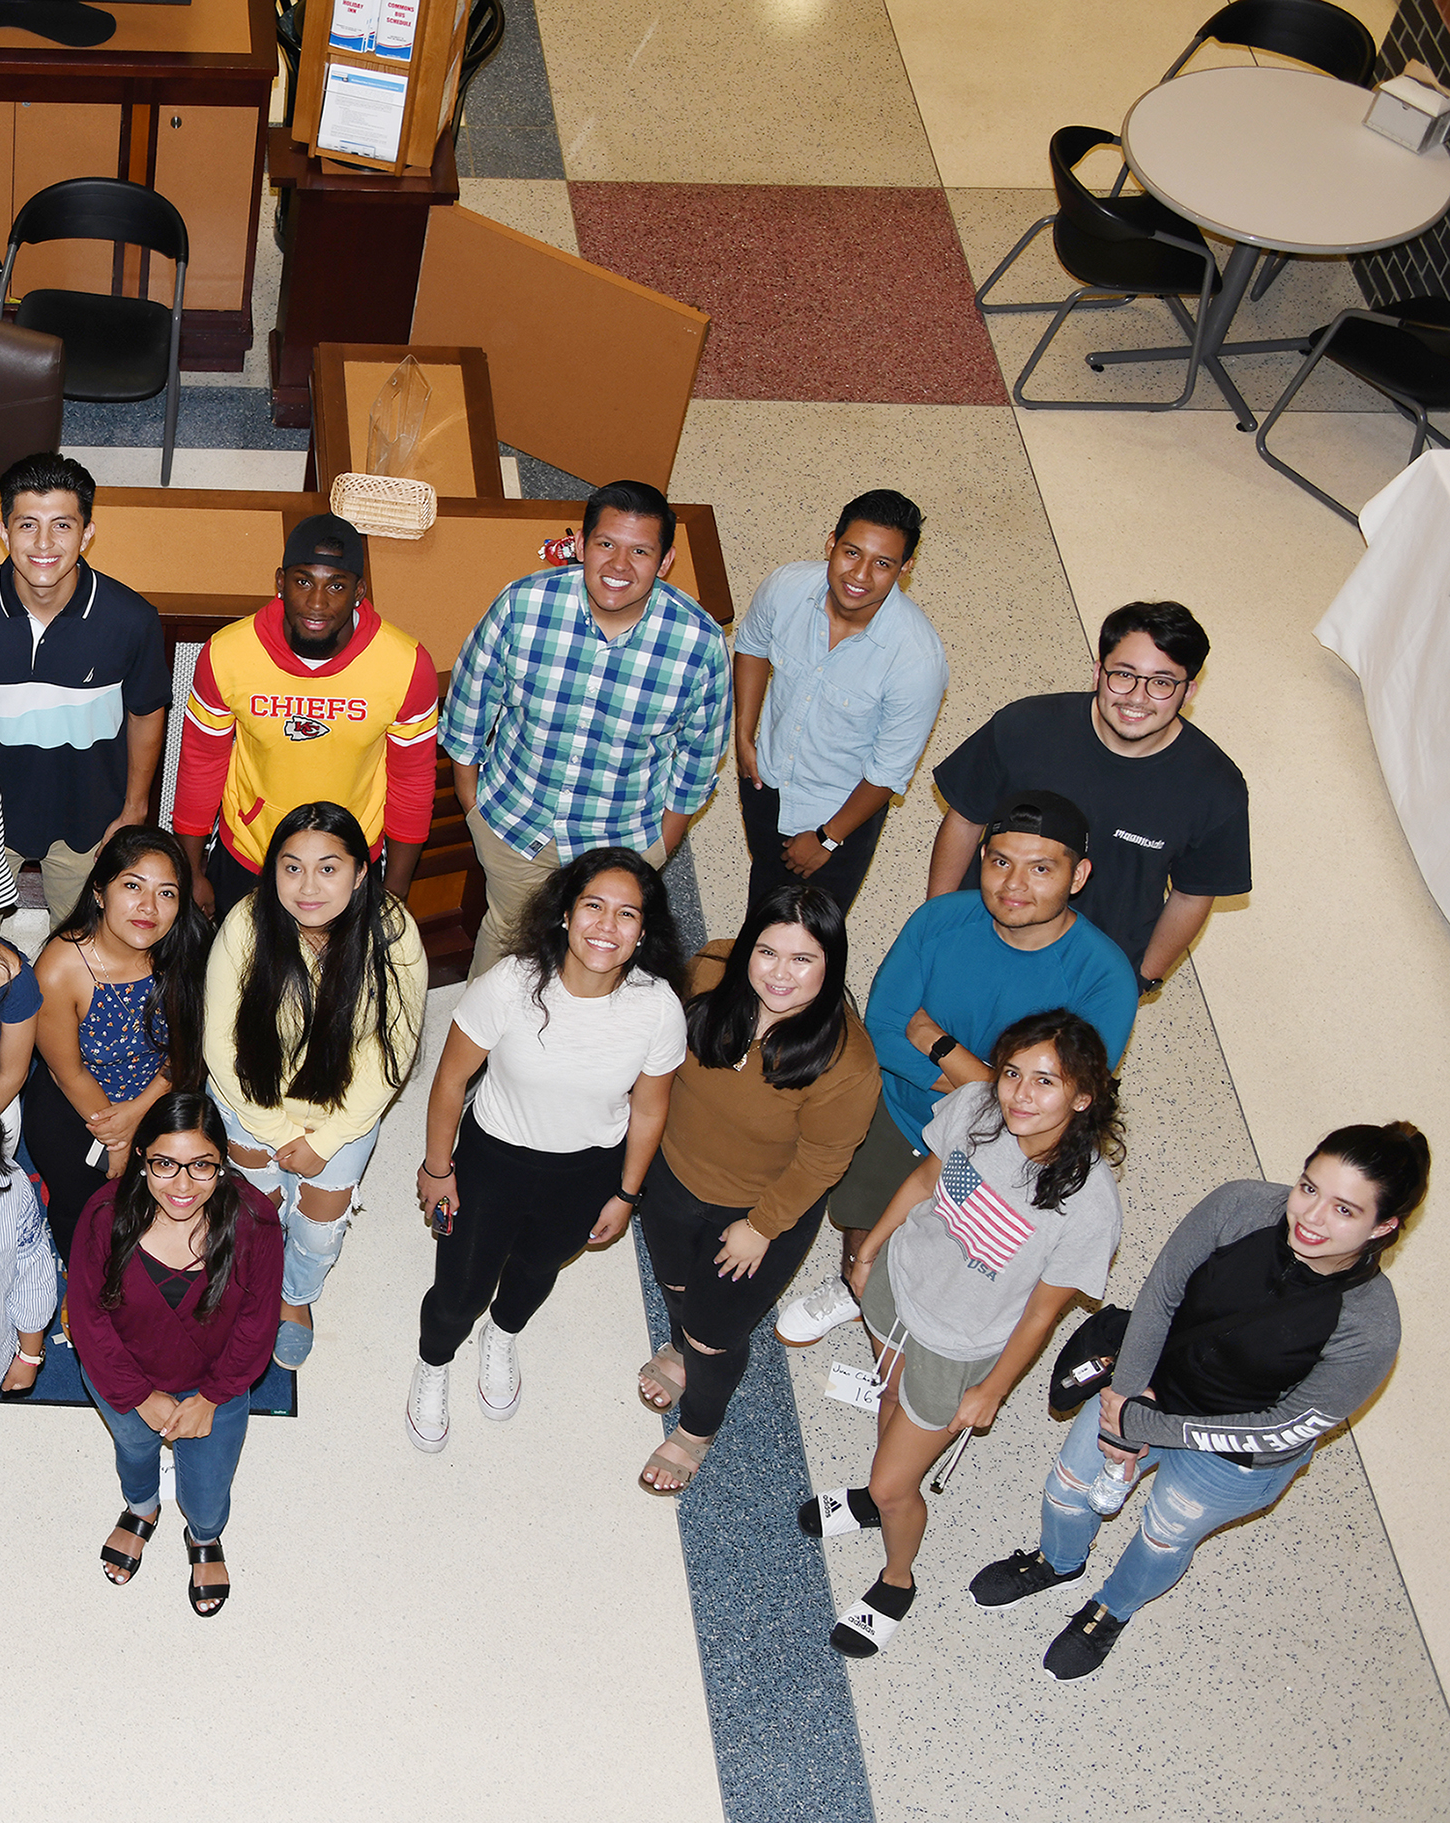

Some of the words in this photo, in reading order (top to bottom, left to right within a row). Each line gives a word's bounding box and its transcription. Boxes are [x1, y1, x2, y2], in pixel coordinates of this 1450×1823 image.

[342, 0, 364, 9] HOLIDAY
[387, 2, 415, 12] COMMONS
[386, 17, 412, 27] SCHEDULE
[249, 693, 368, 722] CHIEFS
[294, 721, 320, 737] KC
[966, 1259, 998, 1282] USA
[855, 1387, 873, 1404] 16
[1191, 1431, 1263, 1453] PINK
[1263, 1415, 1336, 1452] LOVE
[822, 1494, 832, 1519] adidas
[847, 1616, 876, 1636] adidas
